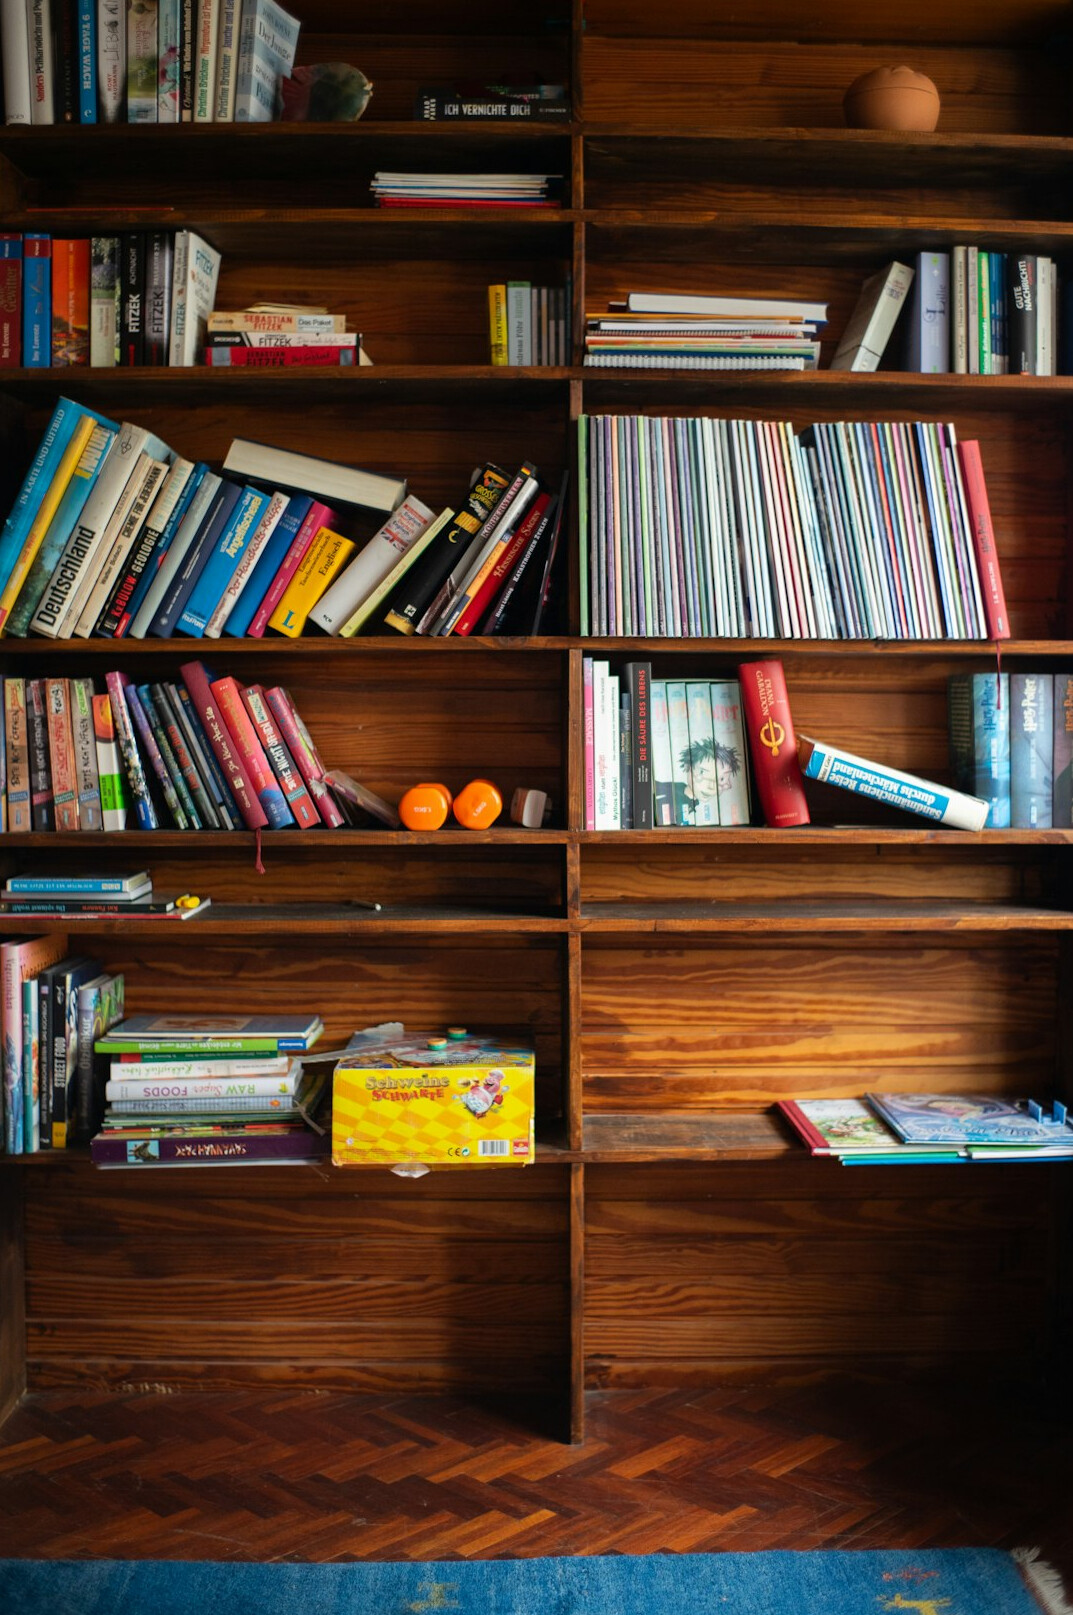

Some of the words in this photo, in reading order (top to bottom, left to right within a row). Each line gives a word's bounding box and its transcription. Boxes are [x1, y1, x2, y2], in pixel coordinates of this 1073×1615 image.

[82, 22, 91, 53] TAGE
[82, 53, 92, 90] WACH
[198, 57, 209, 88] Brückner
[219, 53, 231, 87] Brückner
[198, 88, 208, 118] Christine
[217, 87, 229, 119] Christine
[444, 104, 460, 116] ICH
[461, 103, 508, 116] VERNICHTE
[510, 103, 531, 116] DICH
[1013, 285, 1025, 310] GUTE
[1018, 260, 1033, 312] NACHRICHT!
[128, 293, 141, 333] FITZEK
[151, 290, 164, 333] FITZEK
[175, 302, 187, 336] FITZEK
[243, 314, 293, 325] SEBASTIAN
[252, 322, 283, 332] FITZEK
[258, 337, 292, 348] FITZEK
[41, 407, 69, 448] LUFTBILD
[33, 445, 51, 469] UND
[23, 466, 44, 494] KARTE
[19, 492, 31, 505] IN
[130, 528, 162, 575] GEOLOGIE
[232, 496, 286, 579] Haushalts-Knigge
[511, 538, 541, 583] KATASTROPHEN
[533, 517, 552, 542] ZYKLEN
[318, 540, 343, 577] Englisch
[36, 524, 97, 628] Deutschland
[227, 576, 244, 597] Der
[281, 609, 296, 630] L
[638, 669, 647, 700] LEBENS
[754, 670, 771, 718] GABALDON
[763, 678, 775, 707] DIANA
[980, 679, 995, 707] Potter
[1020, 679, 1038, 707] Potter
[639, 701, 647, 717] DES
[983, 710, 996, 731] Harry
[1023, 708, 1038, 732] Harry
[637, 719, 647, 746] SÄURE
[269, 743, 292, 772] NICHT
[639, 747, 647, 761] DIE
[827, 771, 859, 793] Reise
[832, 761, 900, 795] Märchenland
[858, 782, 944, 820] Sandmännchens
[901, 784, 937, 806] durchs
[54, 1036, 66, 1057] FOOD
[54, 1059, 66, 1088] STREET
[365, 1073, 450, 1090] Schweine
[143, 1085, 188, 1097] FOODS
[225, 1083, 255, 1095] RAW
[371, 1088, 445, 1102] SCHWARTE
